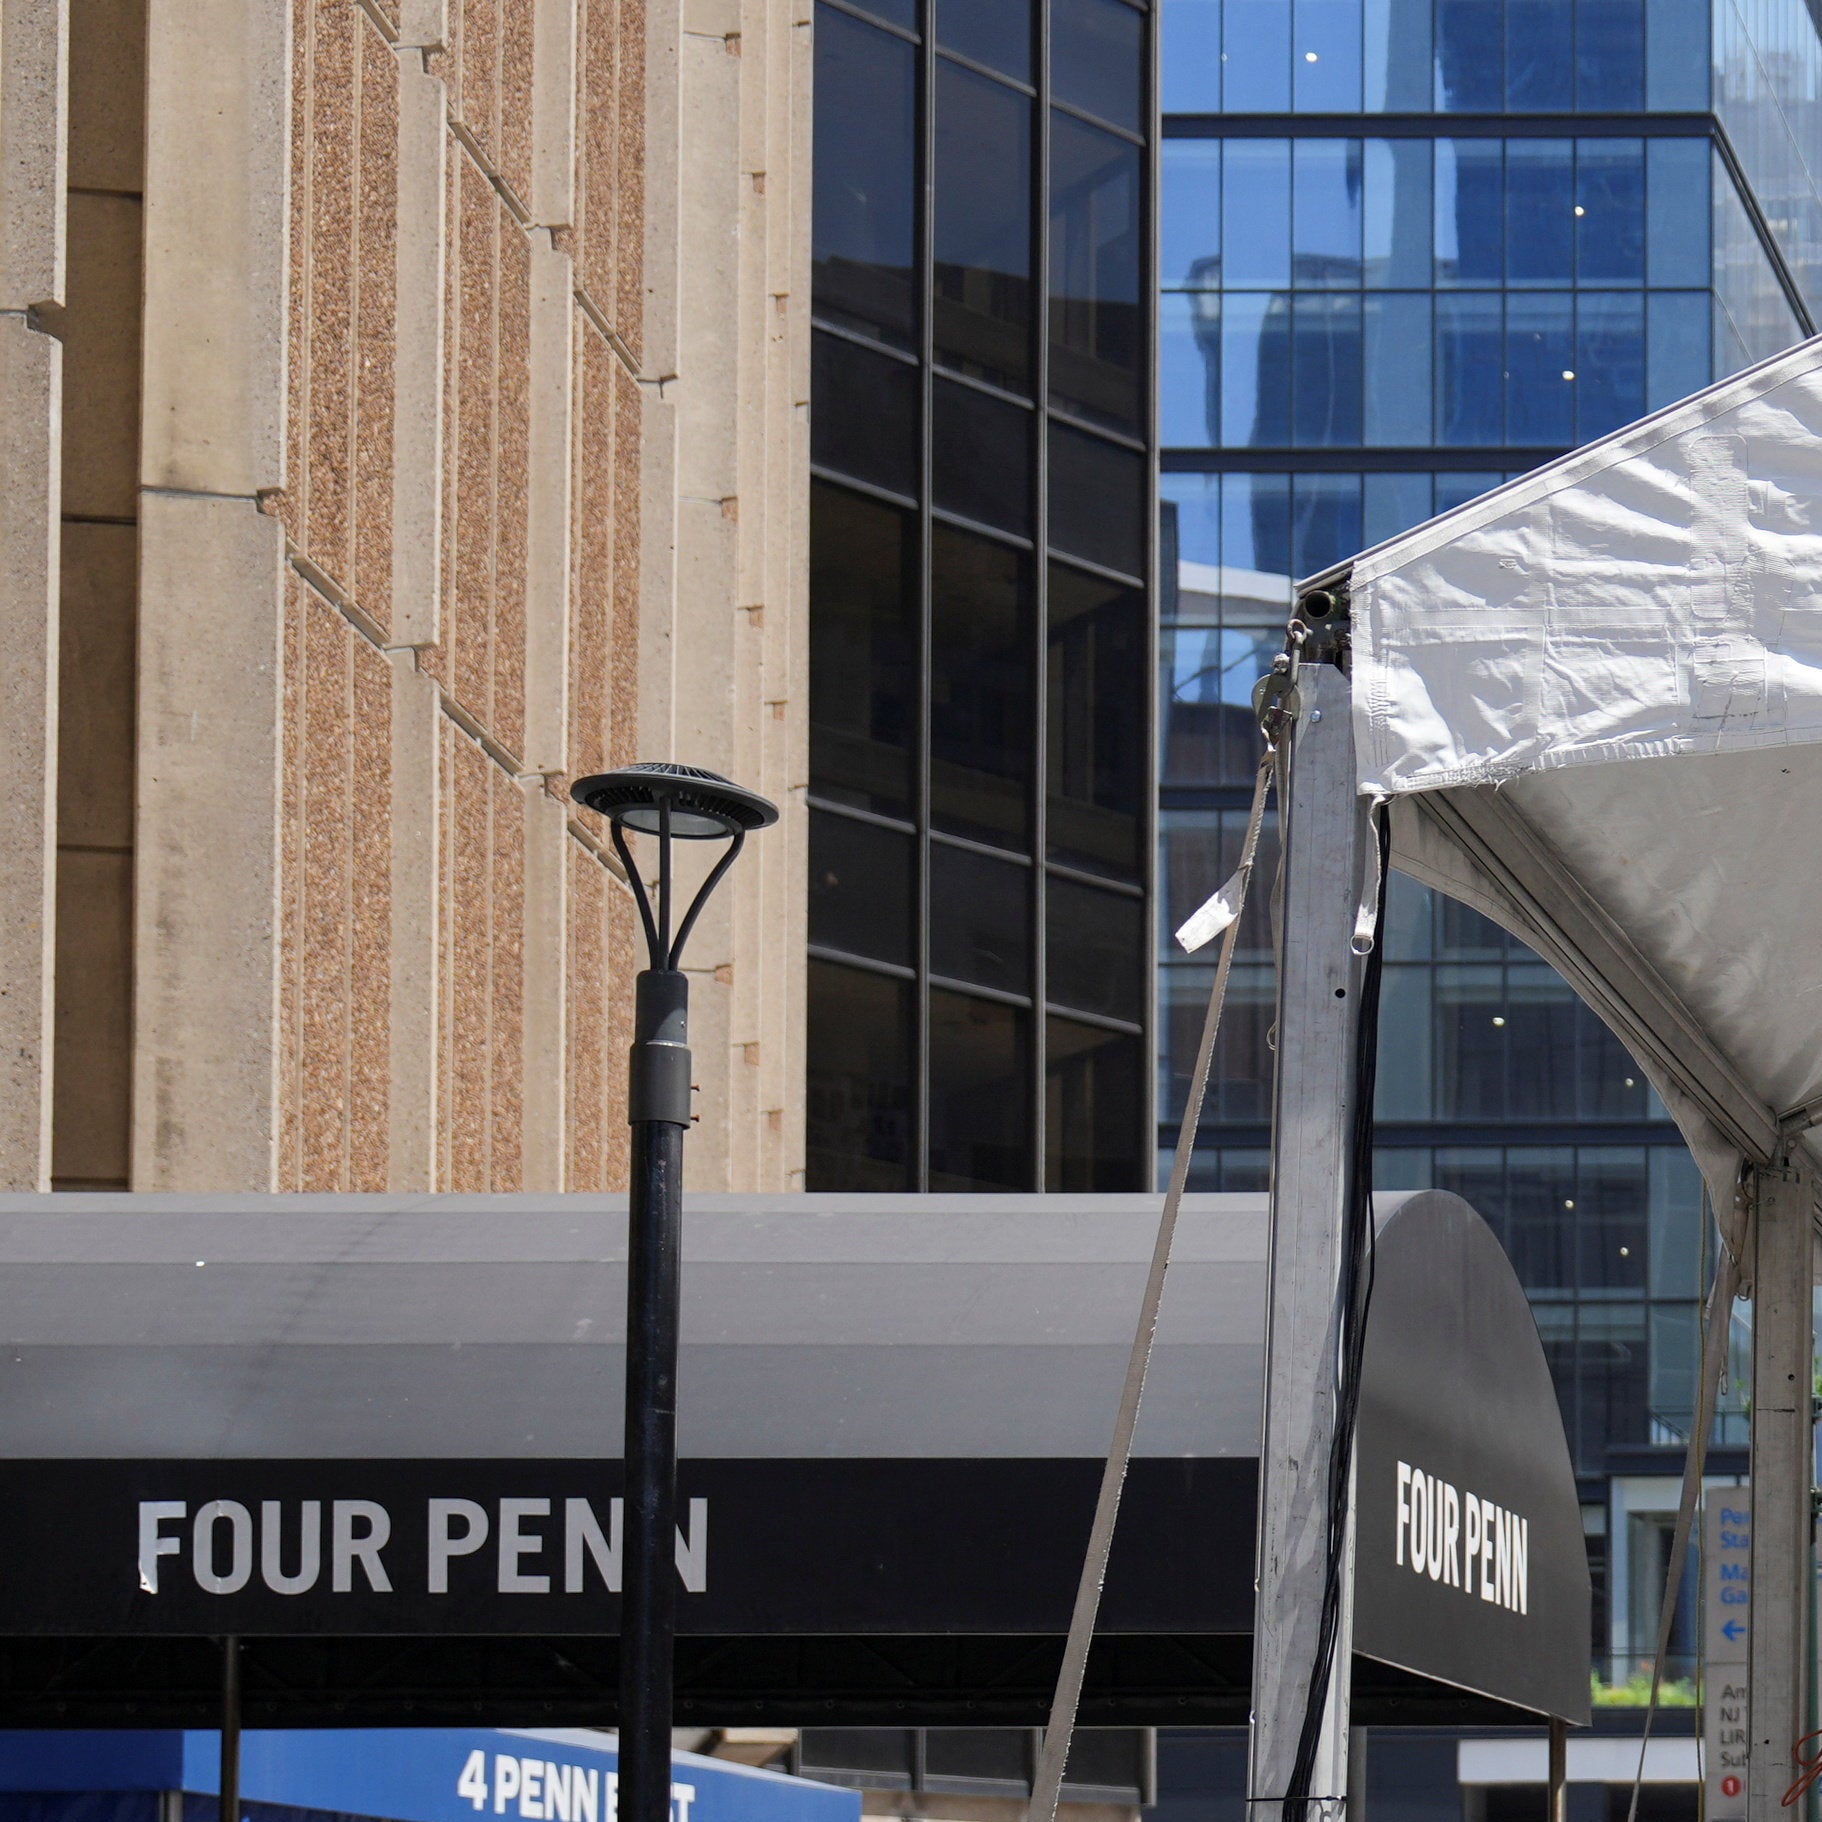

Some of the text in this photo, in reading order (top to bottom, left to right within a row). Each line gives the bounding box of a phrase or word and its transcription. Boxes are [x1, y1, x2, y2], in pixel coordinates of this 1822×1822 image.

[138, 1499, 393, 1595] FOUR
[1396, 1460, 1528, 1616] FOUR PENN
[1720, 1707, 1741, 1722] NJ
[1720, 1729, 1746, 1746] LIR
[457, 1749, 487, 1811] 4
